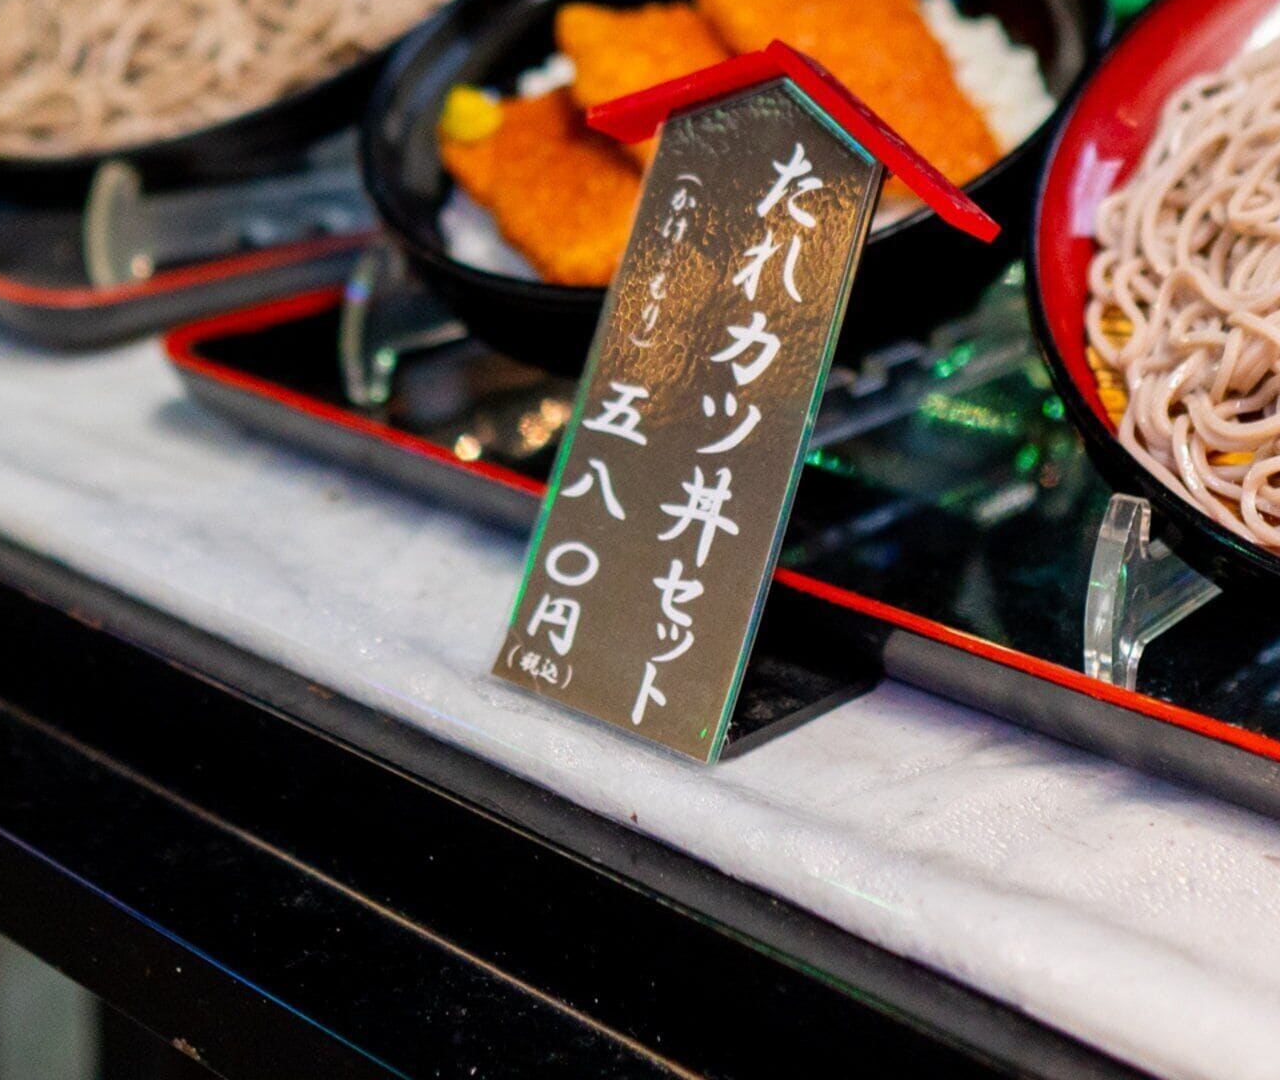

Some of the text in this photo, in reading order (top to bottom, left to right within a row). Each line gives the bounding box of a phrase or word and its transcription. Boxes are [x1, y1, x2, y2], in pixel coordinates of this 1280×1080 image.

[631, 142, 822, 725] たれカツ丼セット
